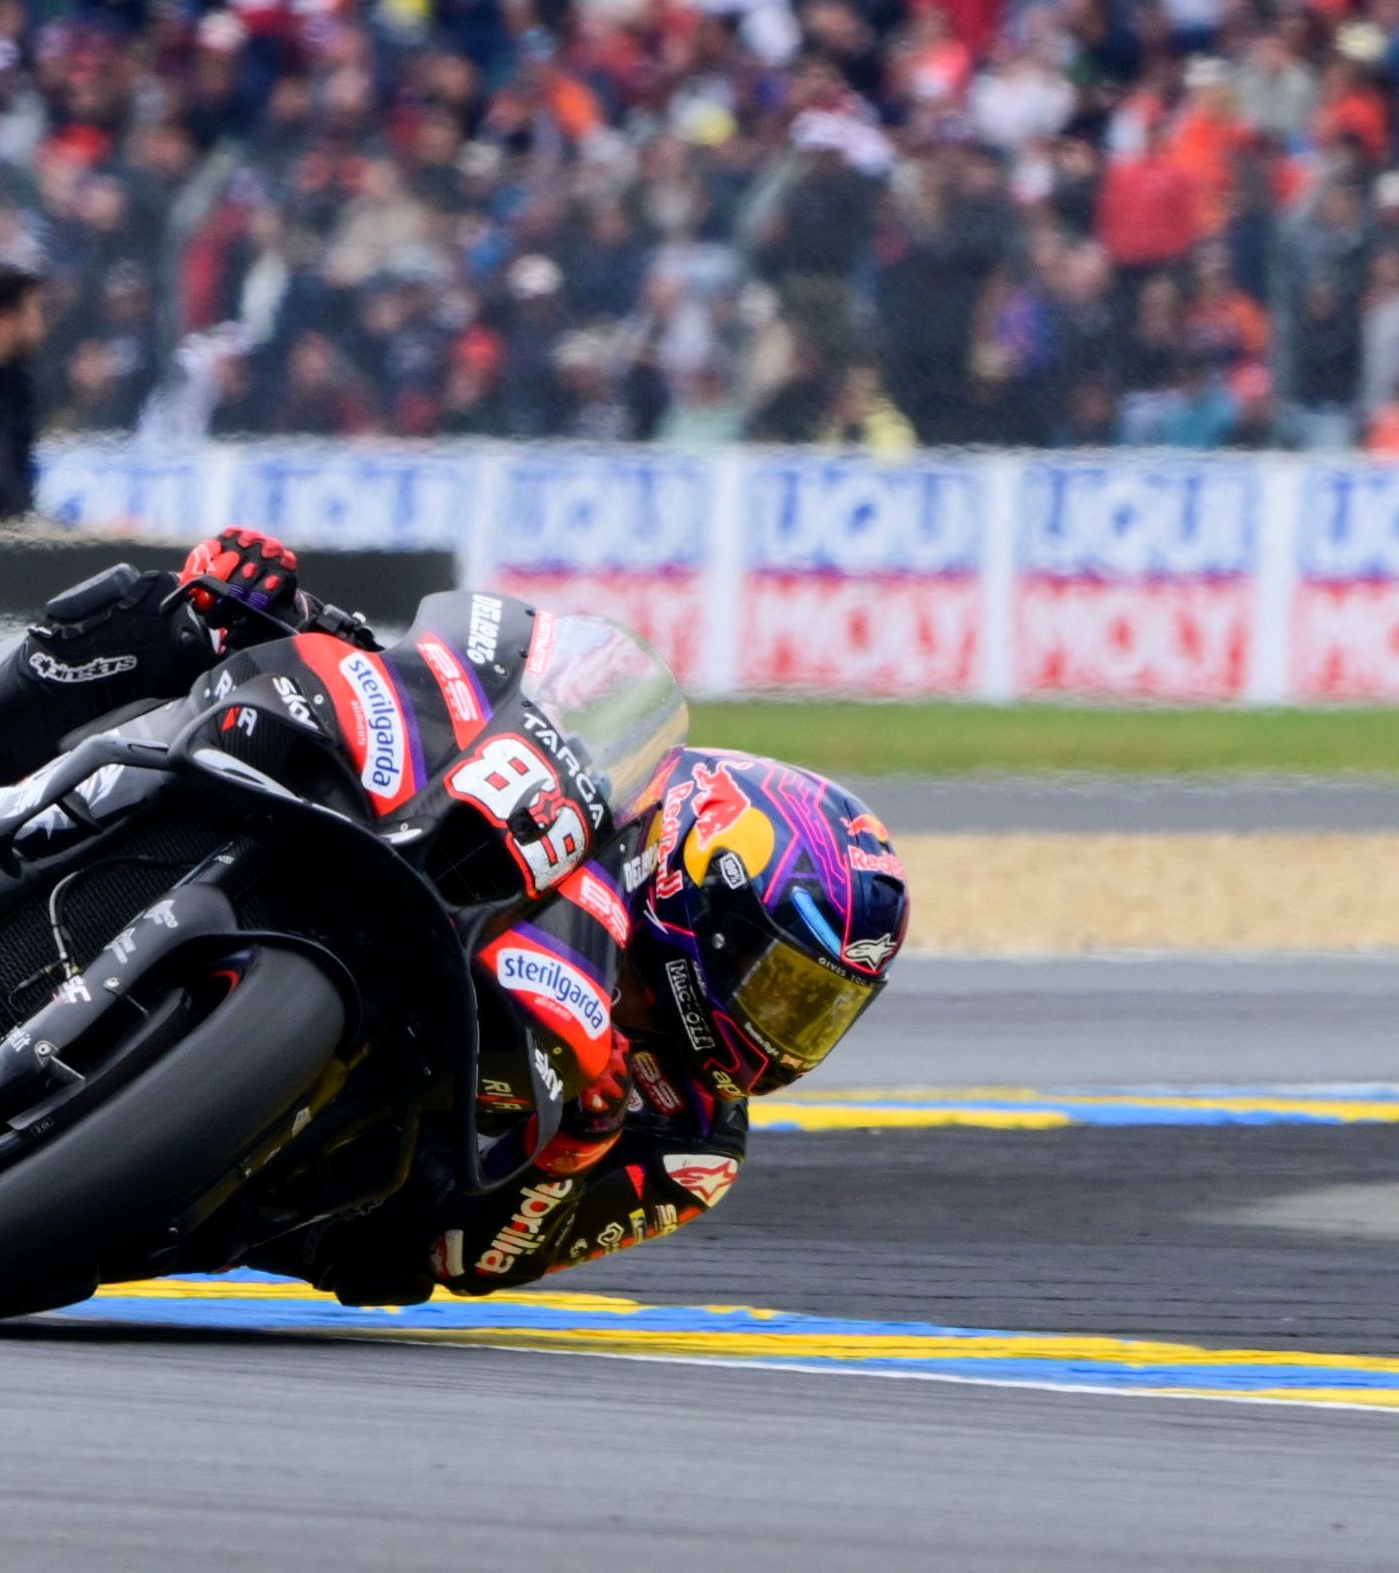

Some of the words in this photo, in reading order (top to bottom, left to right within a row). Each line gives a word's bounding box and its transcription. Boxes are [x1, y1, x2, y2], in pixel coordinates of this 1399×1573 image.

[349, 659, 400, 787] sterilgarda
[522, 712, 605, 830] TARGA
[450, 737, 586, 893] 89
[504, 956, 603, 1030] sterilgarda
[474, 1178, 573, 1274] aprilia
